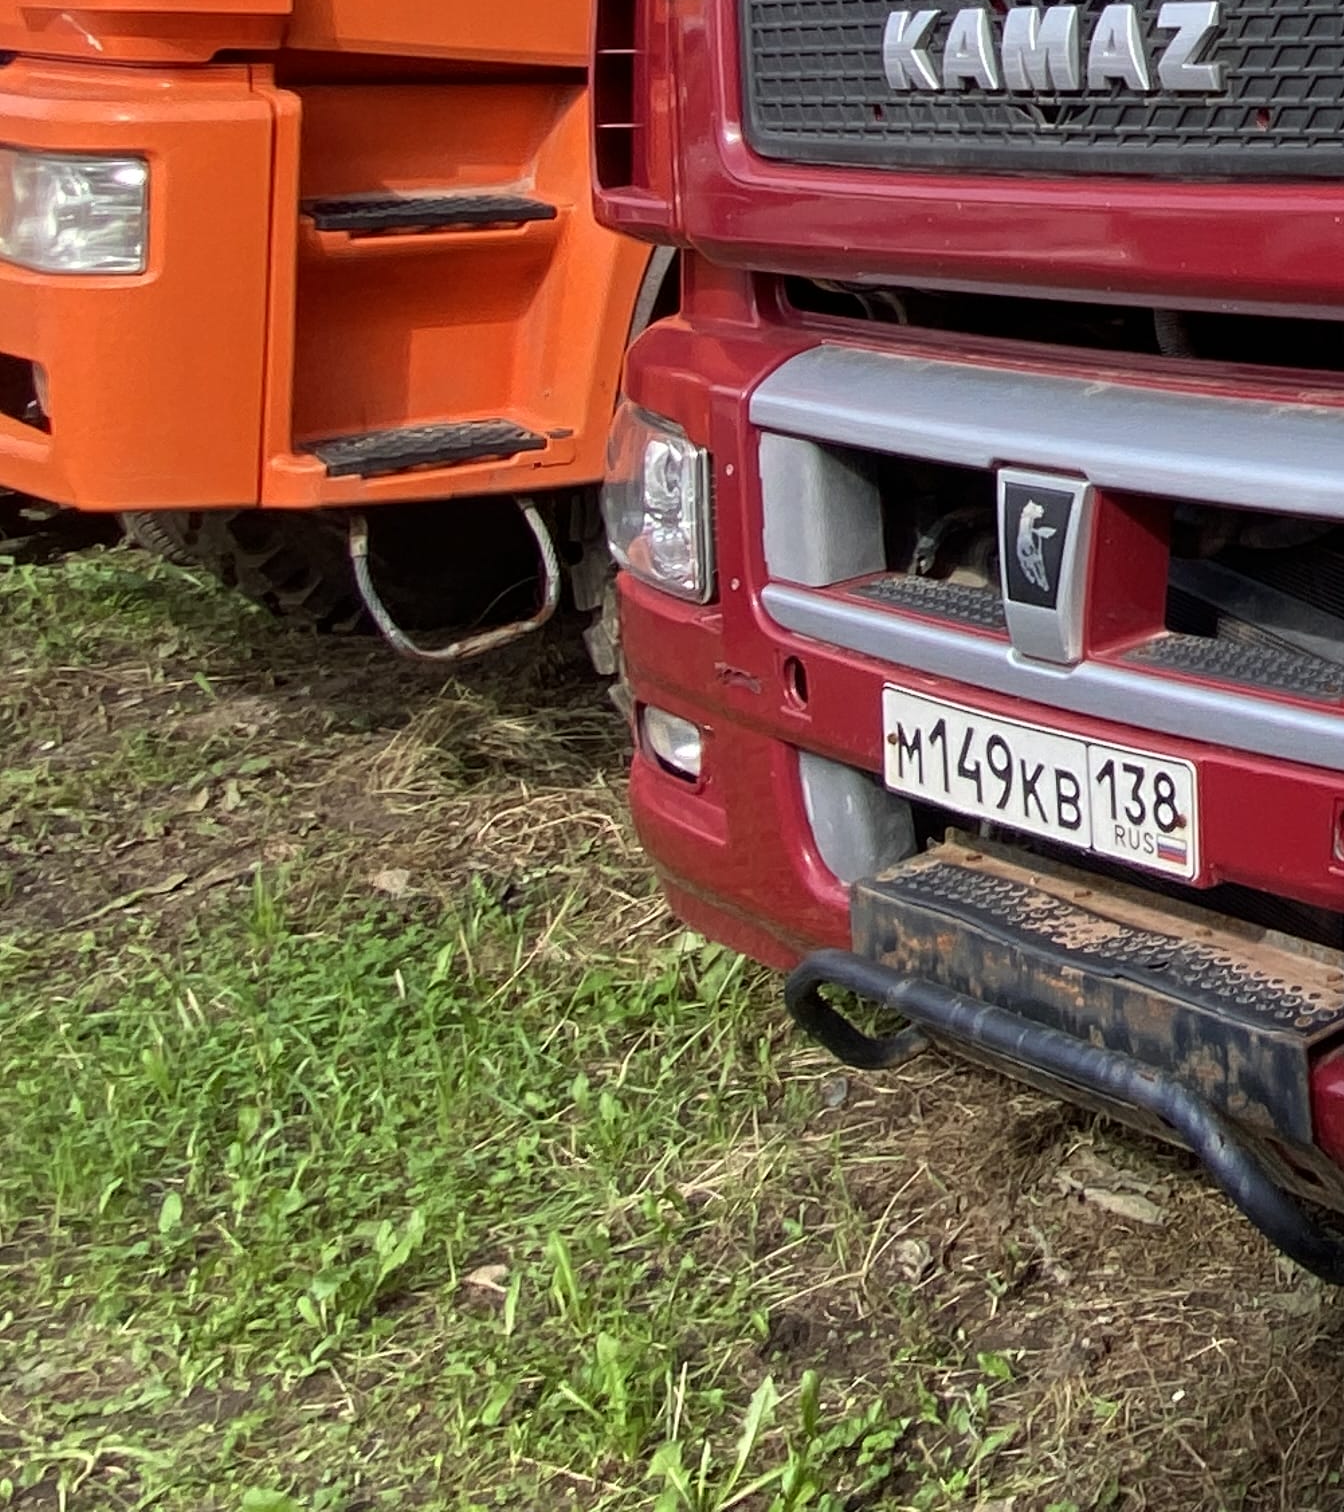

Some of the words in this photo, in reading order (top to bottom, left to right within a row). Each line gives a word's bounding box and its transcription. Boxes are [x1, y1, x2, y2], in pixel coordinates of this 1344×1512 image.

[883, 1, 1225, 91] KAMAZ
[1096, 758, 1178, 834] 138
[1114, 824, 1155, 855] RUS
